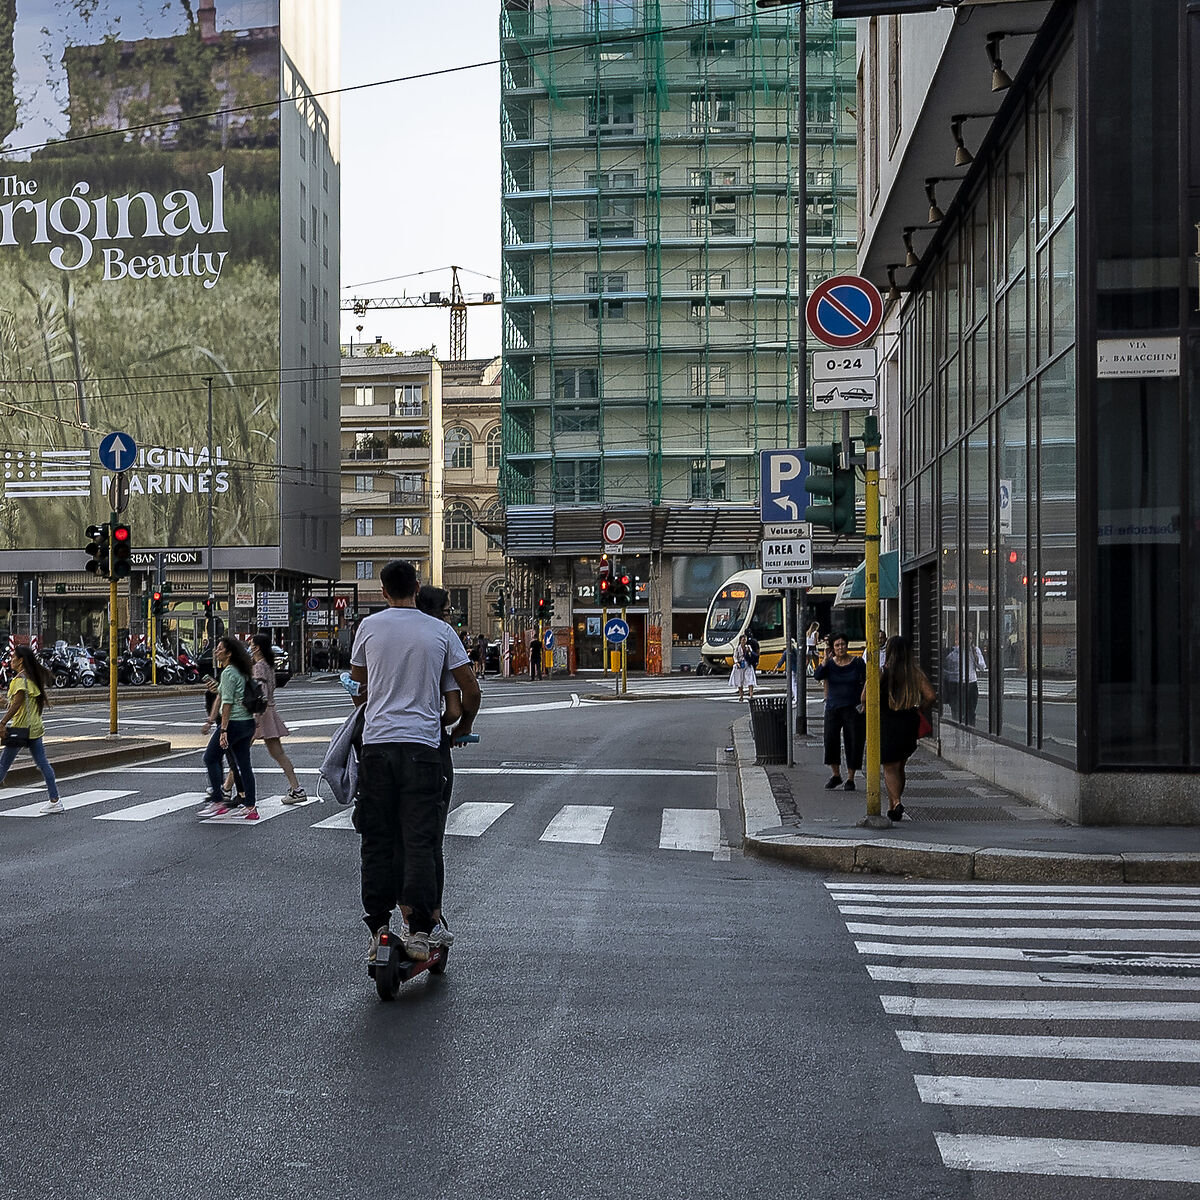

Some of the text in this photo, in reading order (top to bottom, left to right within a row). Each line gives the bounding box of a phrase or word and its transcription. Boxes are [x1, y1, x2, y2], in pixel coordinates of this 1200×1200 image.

[102, 243, 229, 289] Beauty
[1113, 353, 1177, 362] BARACCHINI
[826, 358, 862, 370] 0-24
[131, 446, 229, 469] IGINAL
[770, 454, 802, 493] P
[767, 543, 806, 555] AREA C
[130, 552, 198, 564] RBAN ISION
[767, 575, 808, 585] CAR WASH
